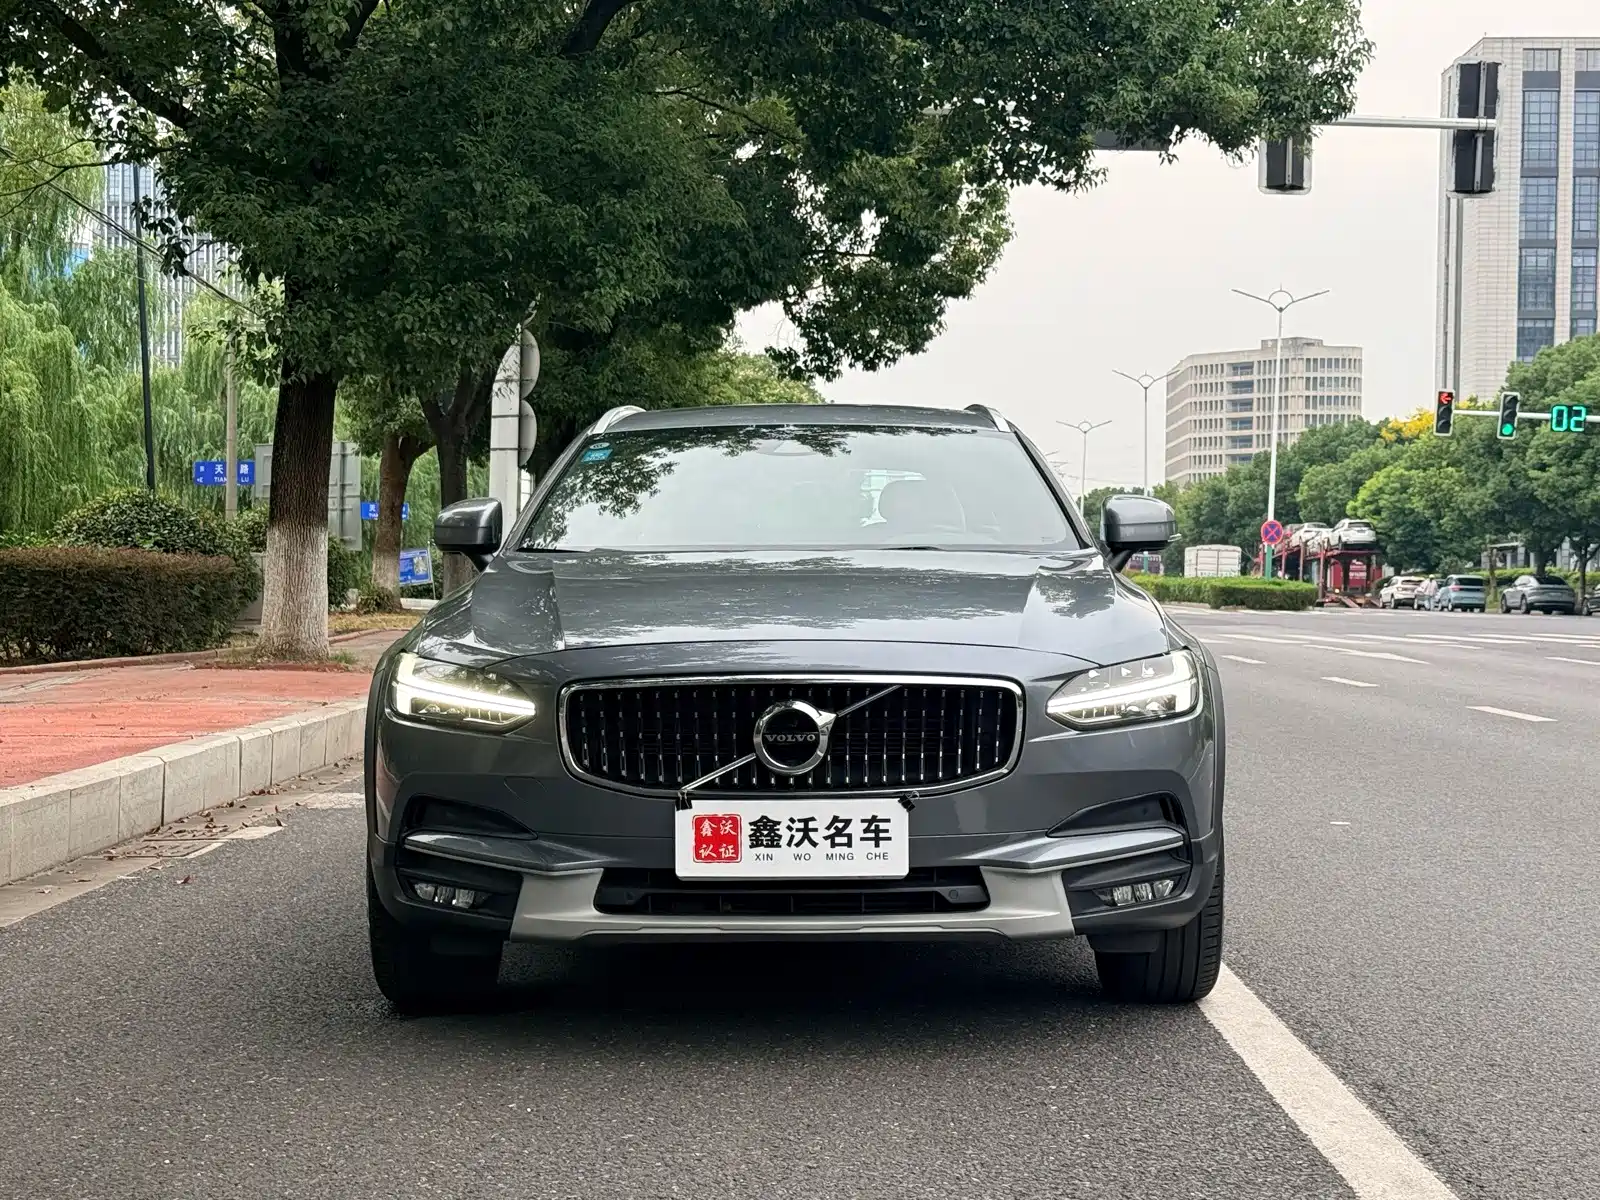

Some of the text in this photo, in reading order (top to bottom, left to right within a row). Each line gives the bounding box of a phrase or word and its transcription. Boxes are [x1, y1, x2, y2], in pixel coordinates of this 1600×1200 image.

[1551, 405, 1586, 432] 02
[764, 734, 816, 742] VOLVO
[700, 818, 738, 837] 鑫沃
[748, 814, 893, 849] 鑫沃名车
[698, 843, 737, 859] 认证
[755, 852, 889, 861] XIN WO MING CHE
